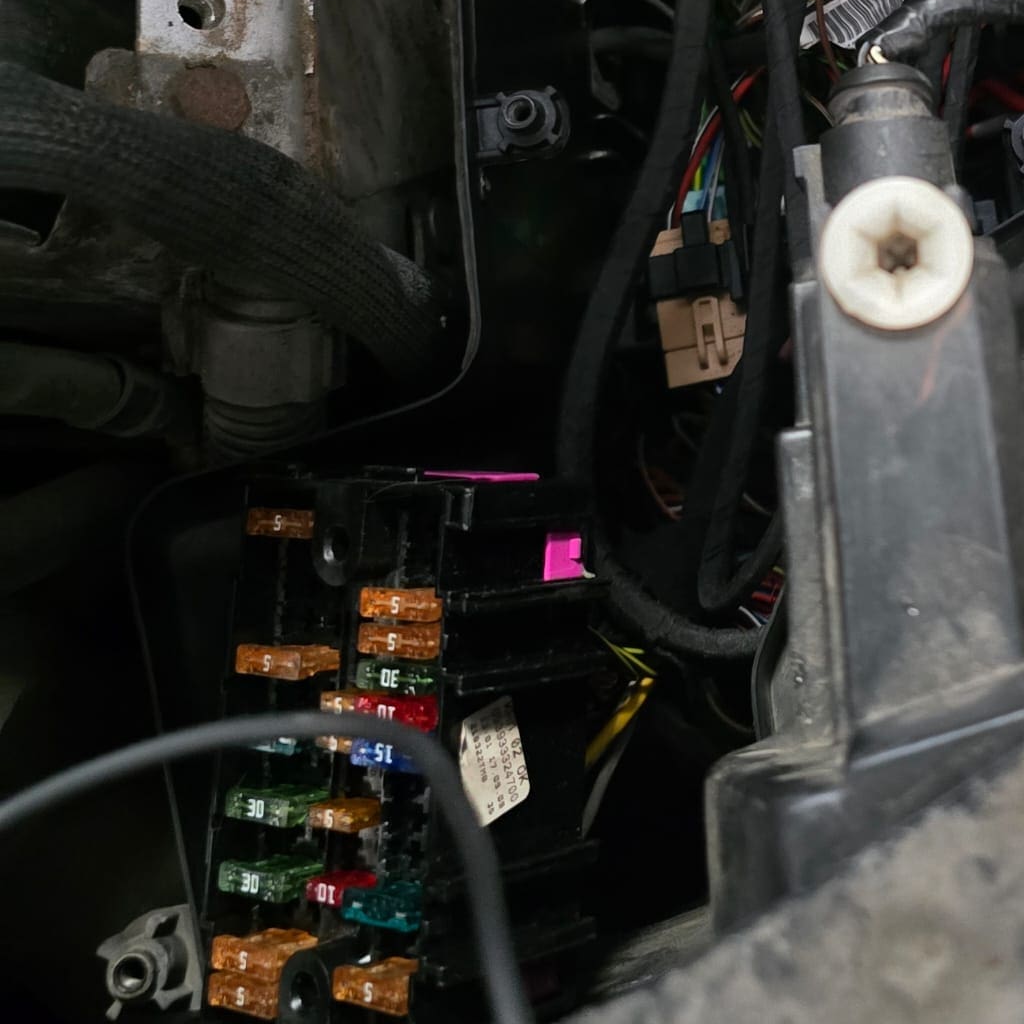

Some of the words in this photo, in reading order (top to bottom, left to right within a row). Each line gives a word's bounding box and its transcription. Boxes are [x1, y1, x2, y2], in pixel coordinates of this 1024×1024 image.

[273, 515, 282, 531] 5
[391, 596, 400, 614] 5
[387, 633, 397, 651] 5
[263, 654, 272, 672] 5
[380, 668, 400, 688] 30
[333, 697, 343, 714] 5
[374, 743, 394, 764] 15
[247, 799, 265, 818] 30
[323, 809, 333, 828] 5
[240, 874, 260, 894] 30
[317, 884, 336, 905] 10
[239, 951, 248, 970] 5
[235, 987, 245, 1006] 5
[364, 982, 374, 1002] 5
